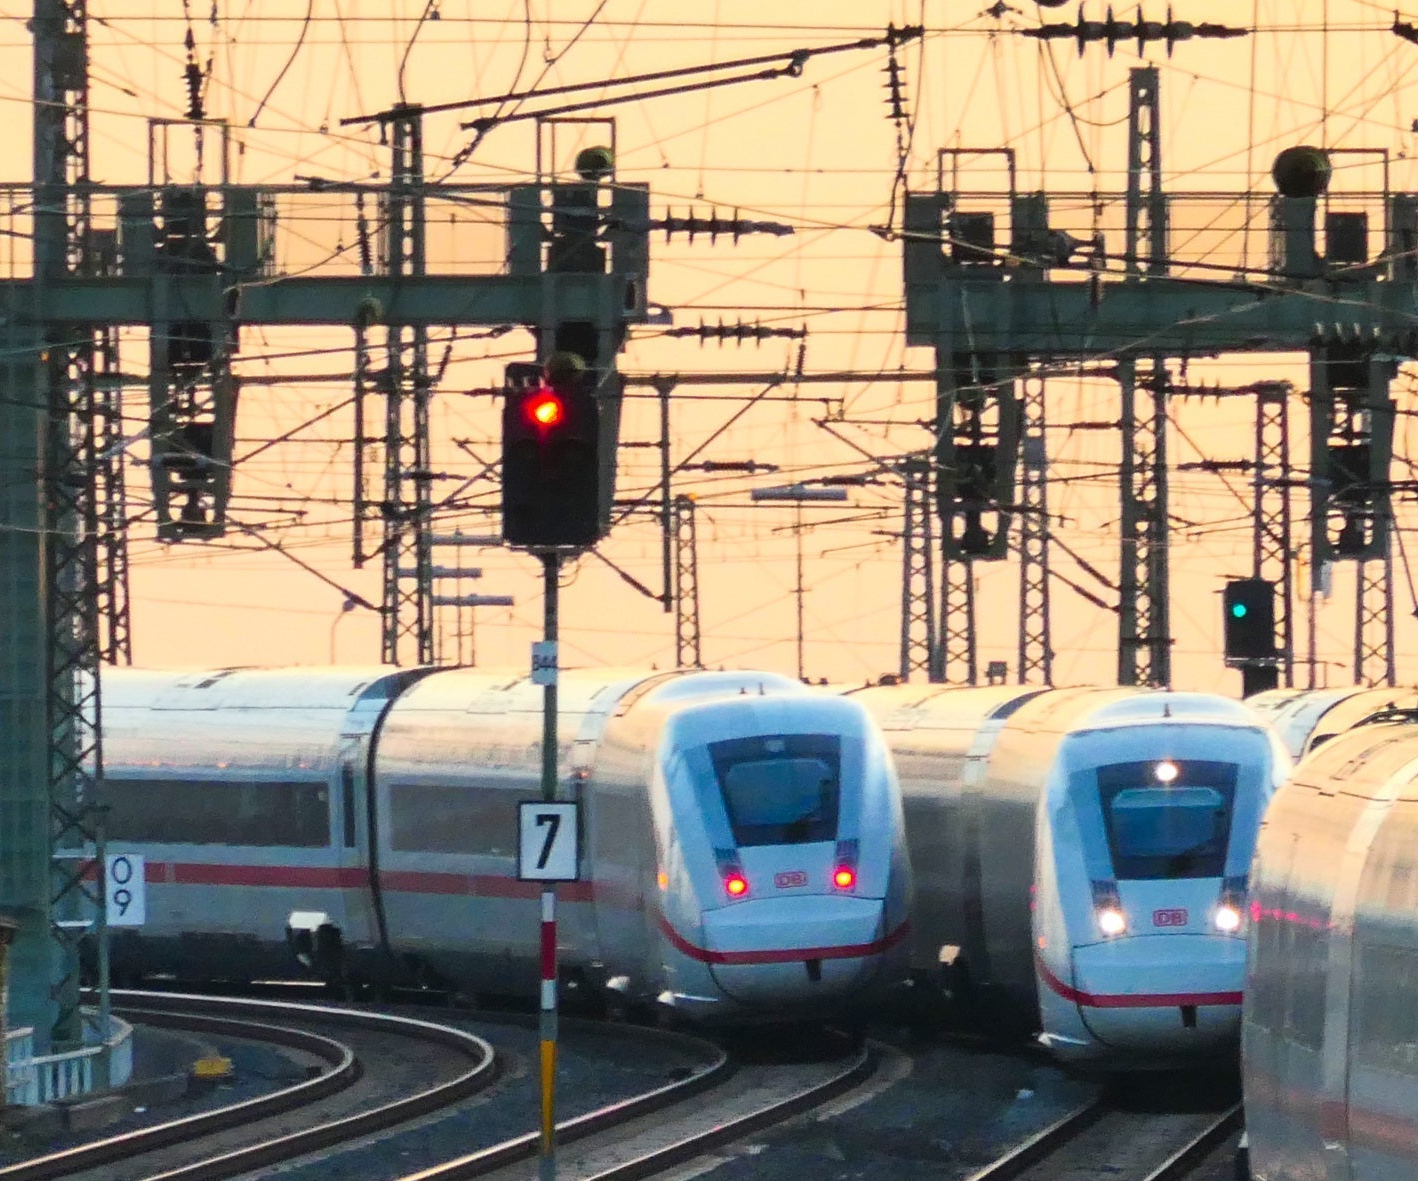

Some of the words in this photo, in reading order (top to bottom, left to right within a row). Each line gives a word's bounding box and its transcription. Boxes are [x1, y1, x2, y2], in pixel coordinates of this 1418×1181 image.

[536, 813, 561, 870] 7
[111, 856, 133, 885] 0
[776, 872, 807, 887] DB
[113, 888, 132, 917] 9
[1155, 910, 1185, 925] DB
